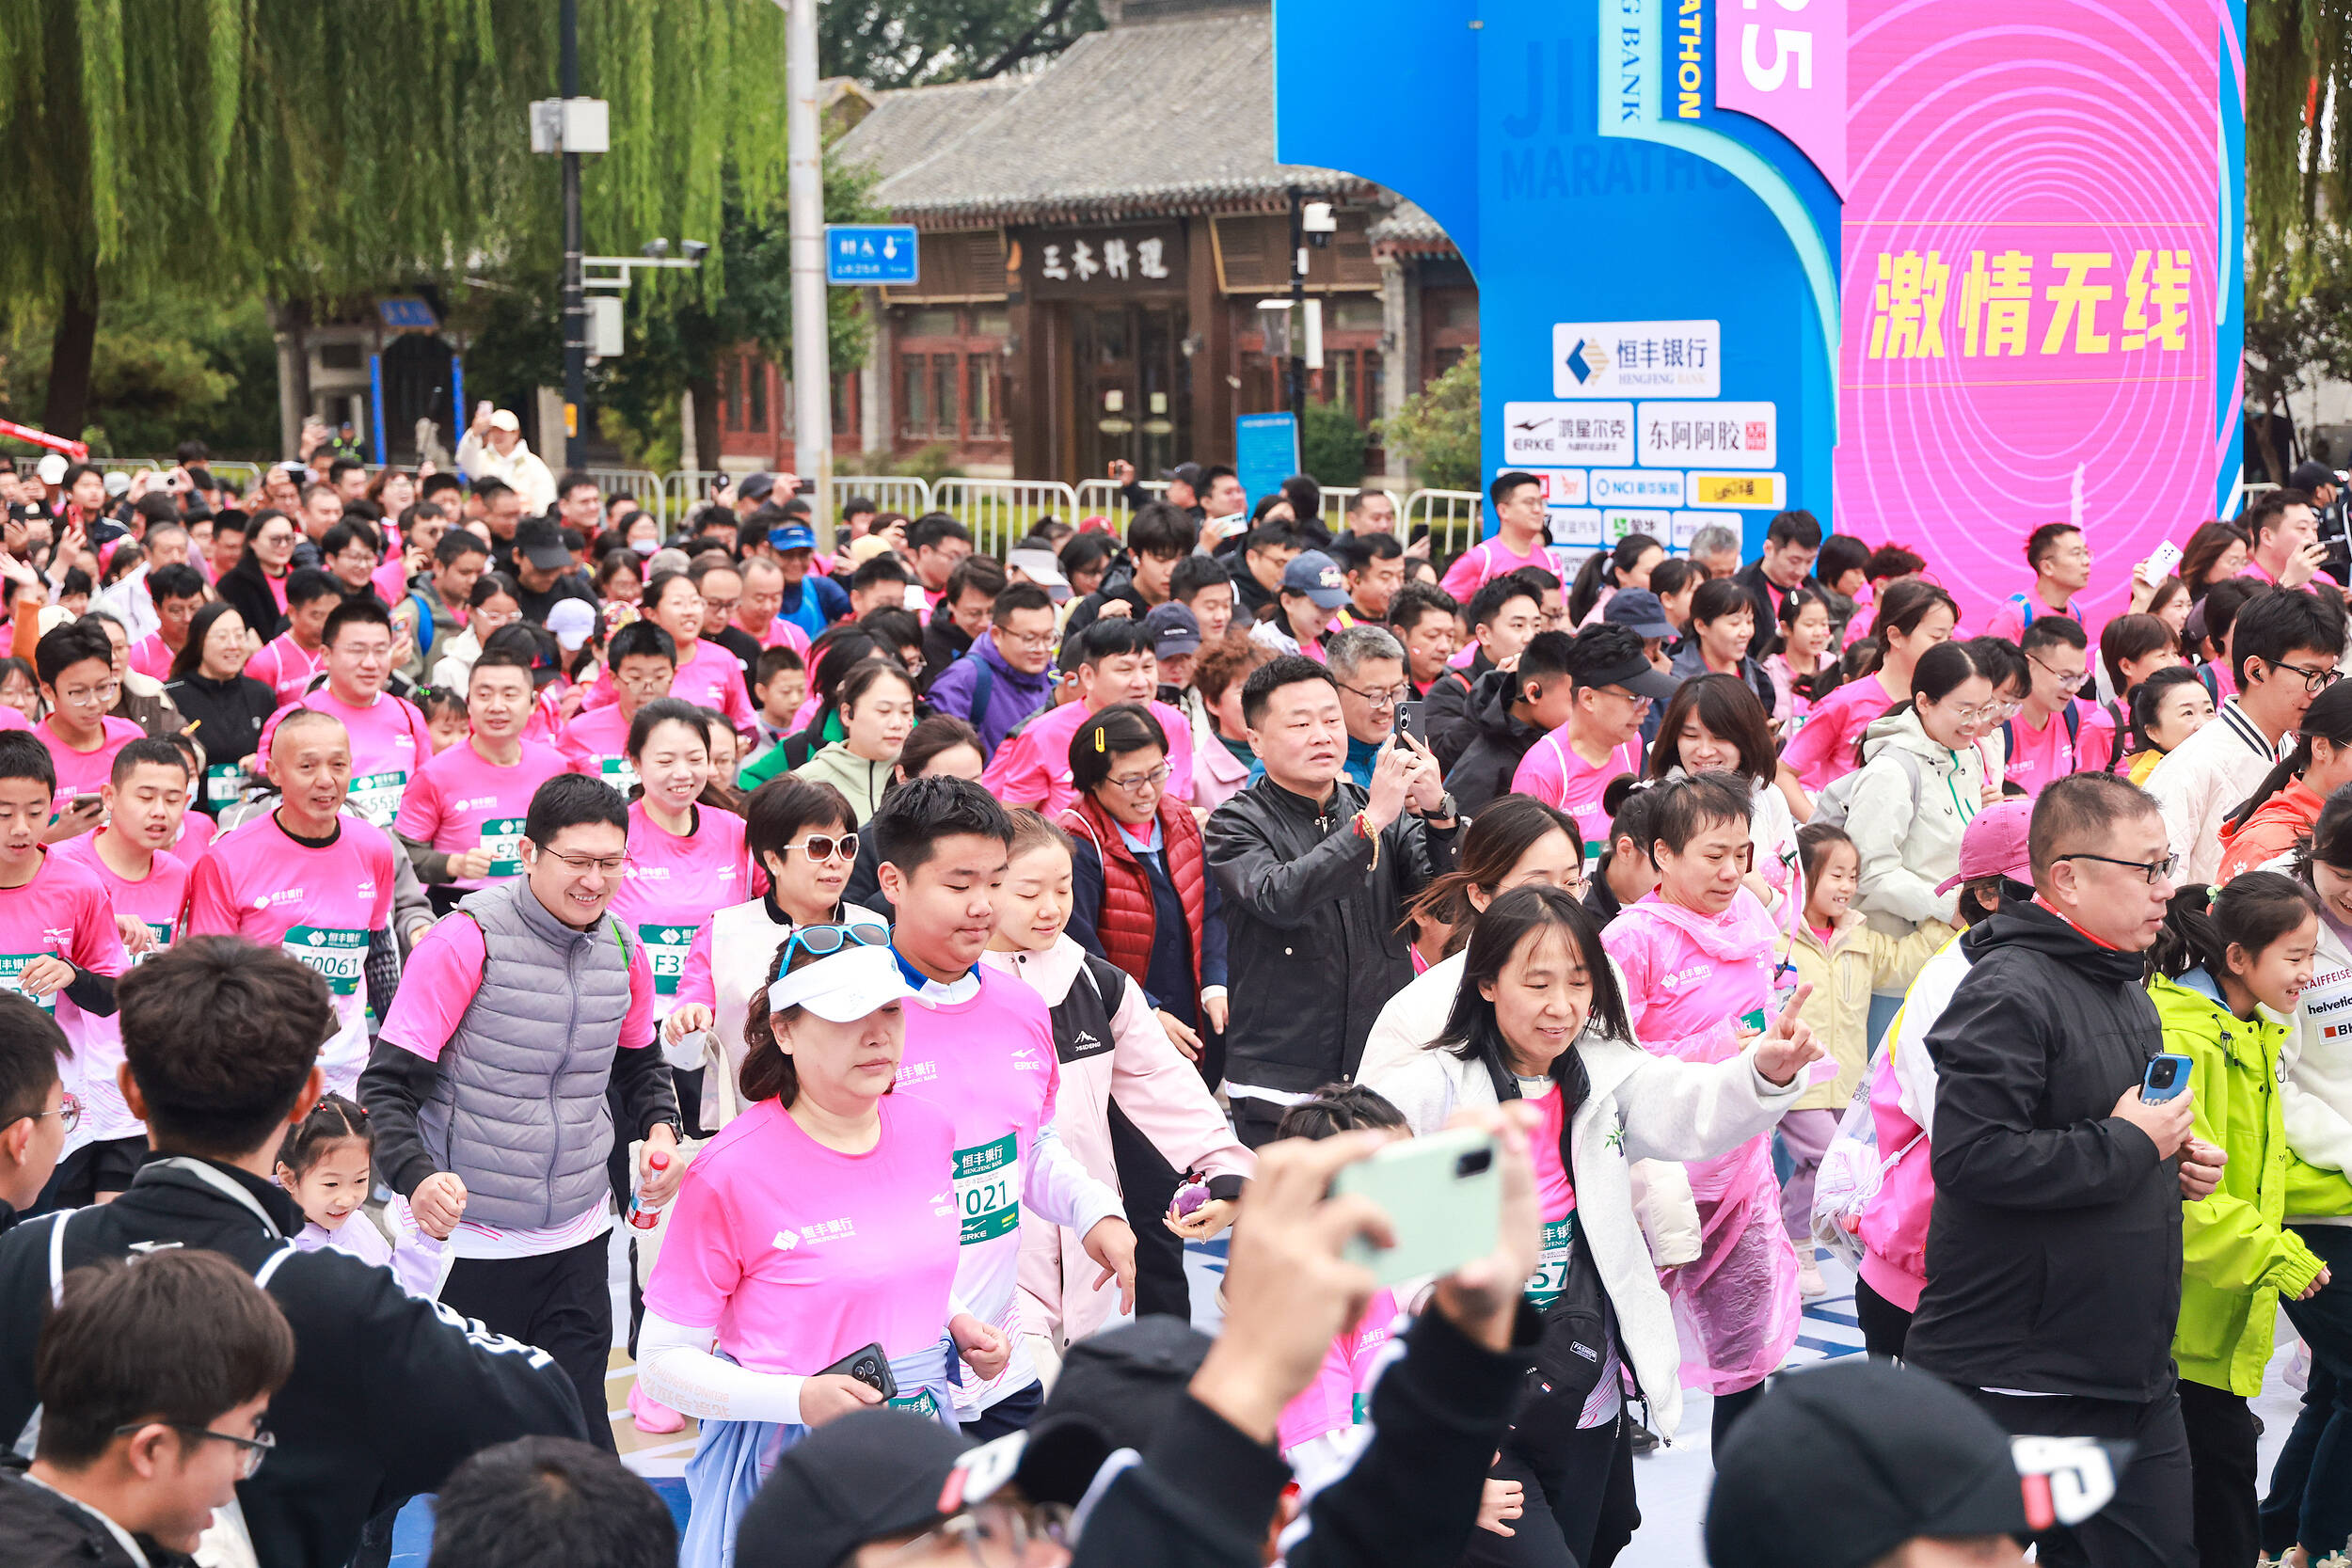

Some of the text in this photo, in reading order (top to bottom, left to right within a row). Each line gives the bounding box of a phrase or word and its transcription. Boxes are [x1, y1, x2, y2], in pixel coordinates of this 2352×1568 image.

[1621, 26, 1641, 122] BANK
[1868, 249, 2191, 359] 激情无线
[1616, 338, 1708, 369] 恒丰银行
[1618, 372, 1675, 385] HENGFENG
[1558, 419, 1626, 440] 鸿星尔克
[1649, 420, 1740, 451] 东阿阿胶
[1513, 437, 1554, 451] ERKE
[655, 955, 687, 974] F3
[1014, 1061, 1040, 1070] ERKE
[961, 1145, 1004, 1169] 恒丰银行
[962, 1163, 992, 1176] HENGFENG
[801, 1217, 852, 1239] 恒丰银行
[959, 1229, 987, 1242] ERKE
